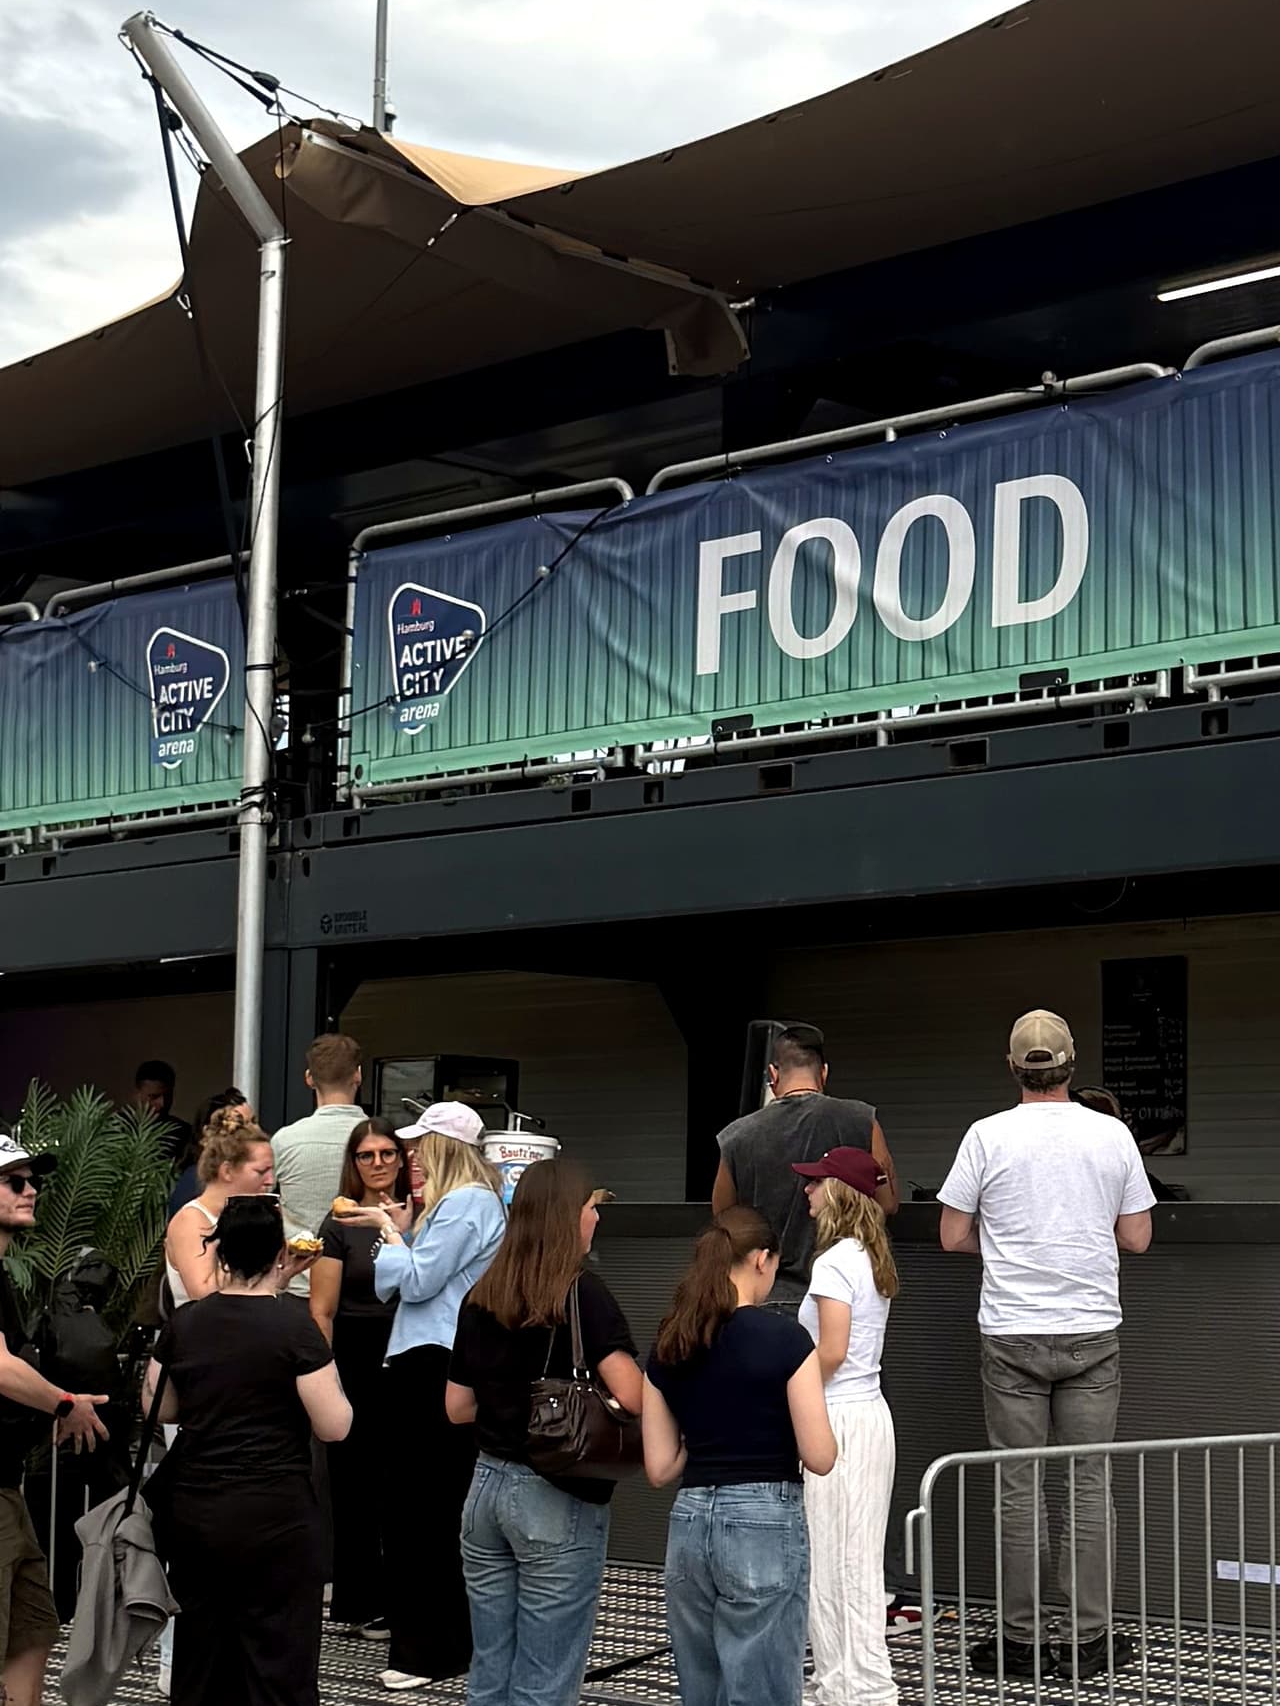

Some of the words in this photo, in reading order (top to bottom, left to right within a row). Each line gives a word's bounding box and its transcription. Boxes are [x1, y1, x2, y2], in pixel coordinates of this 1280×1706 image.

[695, 473, 1090, 676] FOOD
[397, 619, 435, 635] Hamburg
[399, 635, 467, 669] ACTIVE
[153, 662, 188, 675] Hamburg
[402, 667, 445, 696] CITY
[159, 676, 214, 705] ACTIVE
[160, 706, 195, 733] CITY
[399, 702, 440, 722] arena
[158, 738, 195, 757] arena
